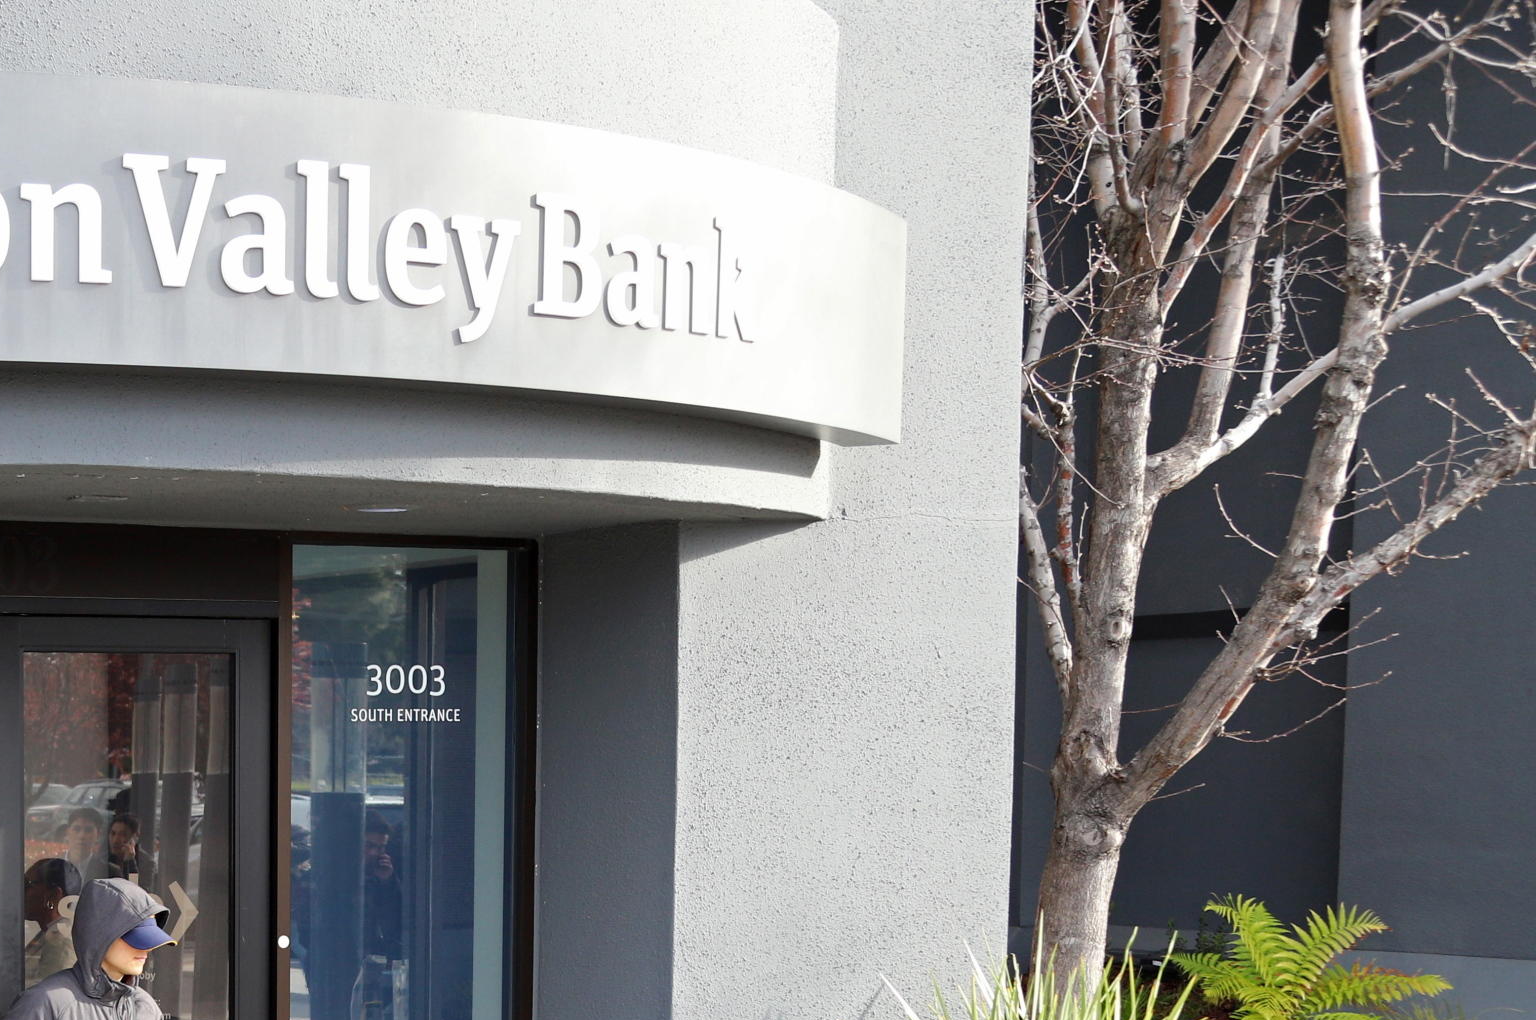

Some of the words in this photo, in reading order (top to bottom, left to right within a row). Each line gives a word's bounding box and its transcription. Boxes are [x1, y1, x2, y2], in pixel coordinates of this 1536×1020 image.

[121, 152, 521, 345] Valley
[528, 192, 757, 344] Bank
[366, 664, 446, 697] 3003
[350, 708, 393, 722] SOUTH
[397, 708, 461, 722] ENTRANCE
